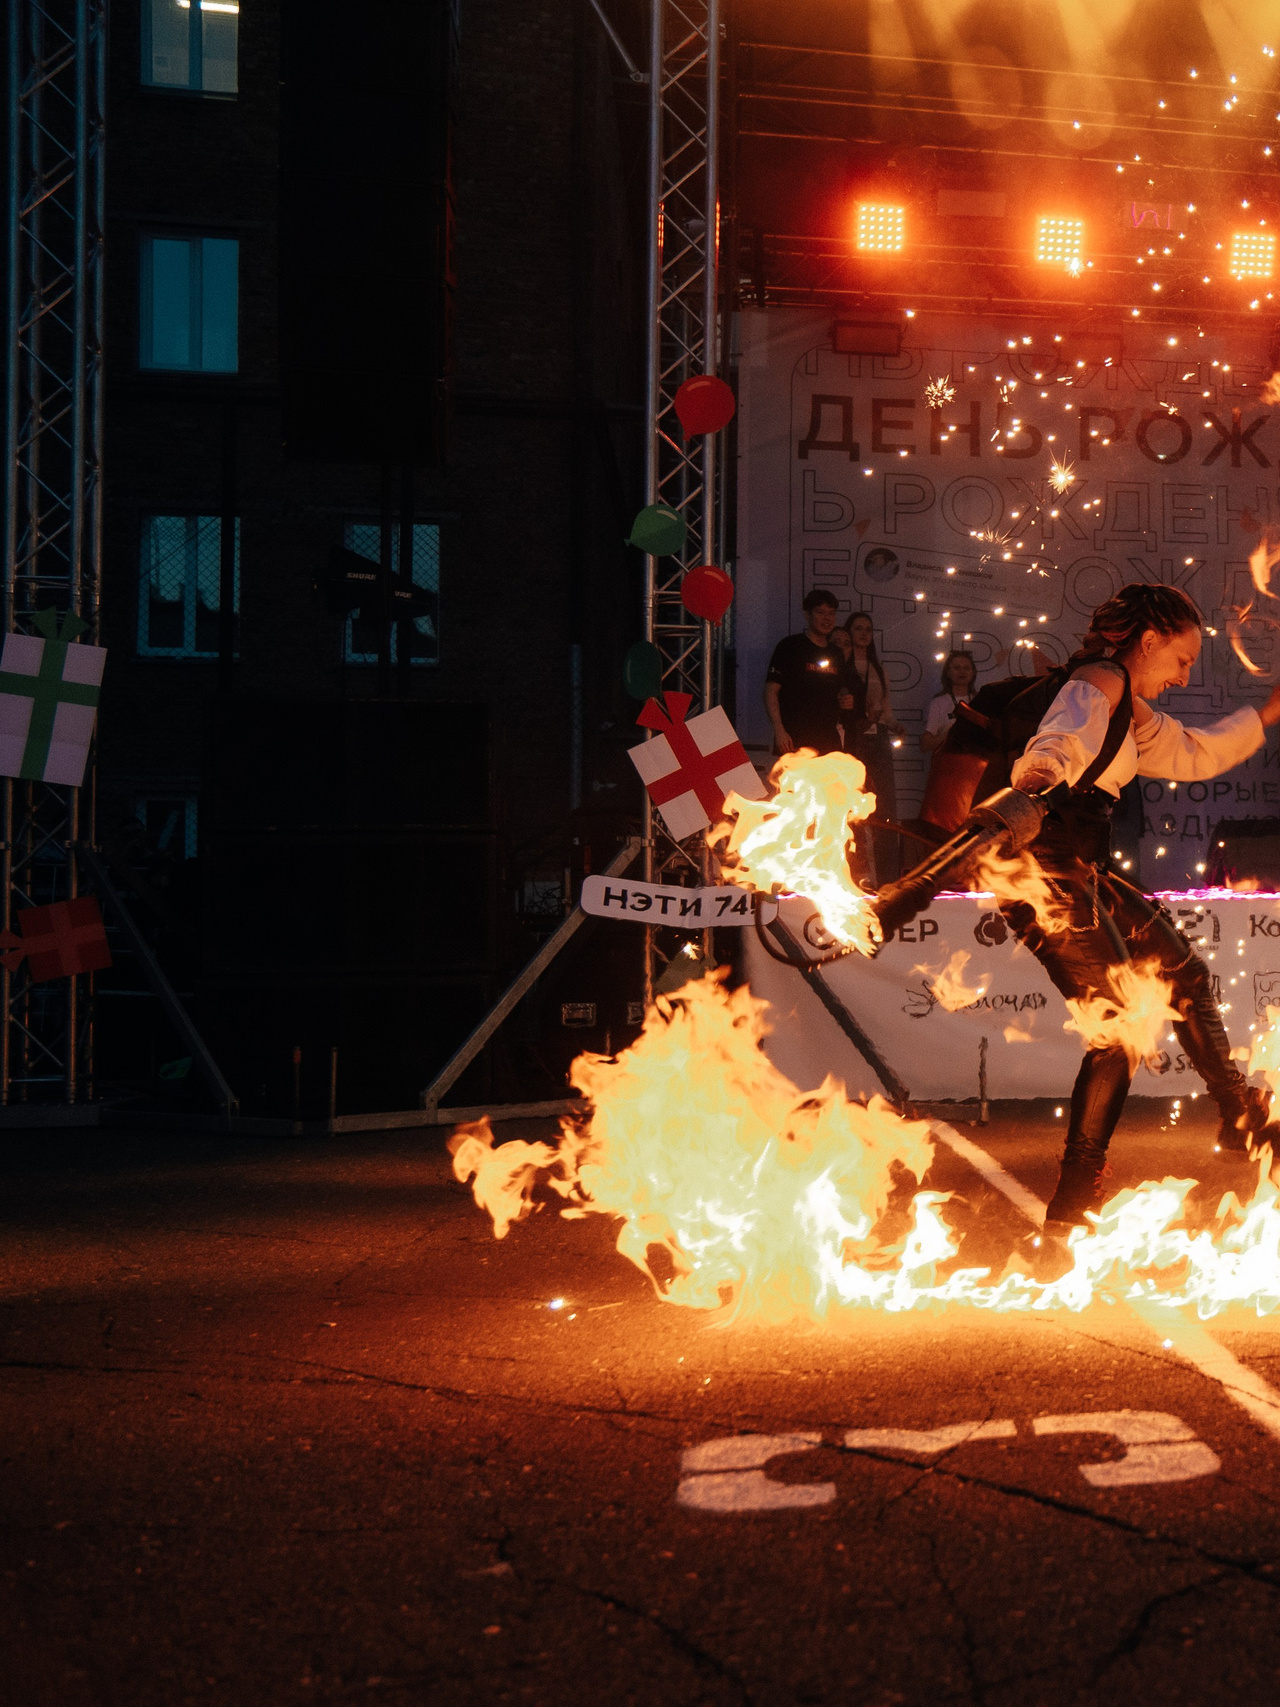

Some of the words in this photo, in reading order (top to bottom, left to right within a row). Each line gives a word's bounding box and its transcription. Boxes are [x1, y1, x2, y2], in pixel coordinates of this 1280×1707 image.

[798, 394, 1043, 462] ДЕНЬ
[603, 886, 702, 917] НЭТИ
[714, 893, 757, 917] 74!
